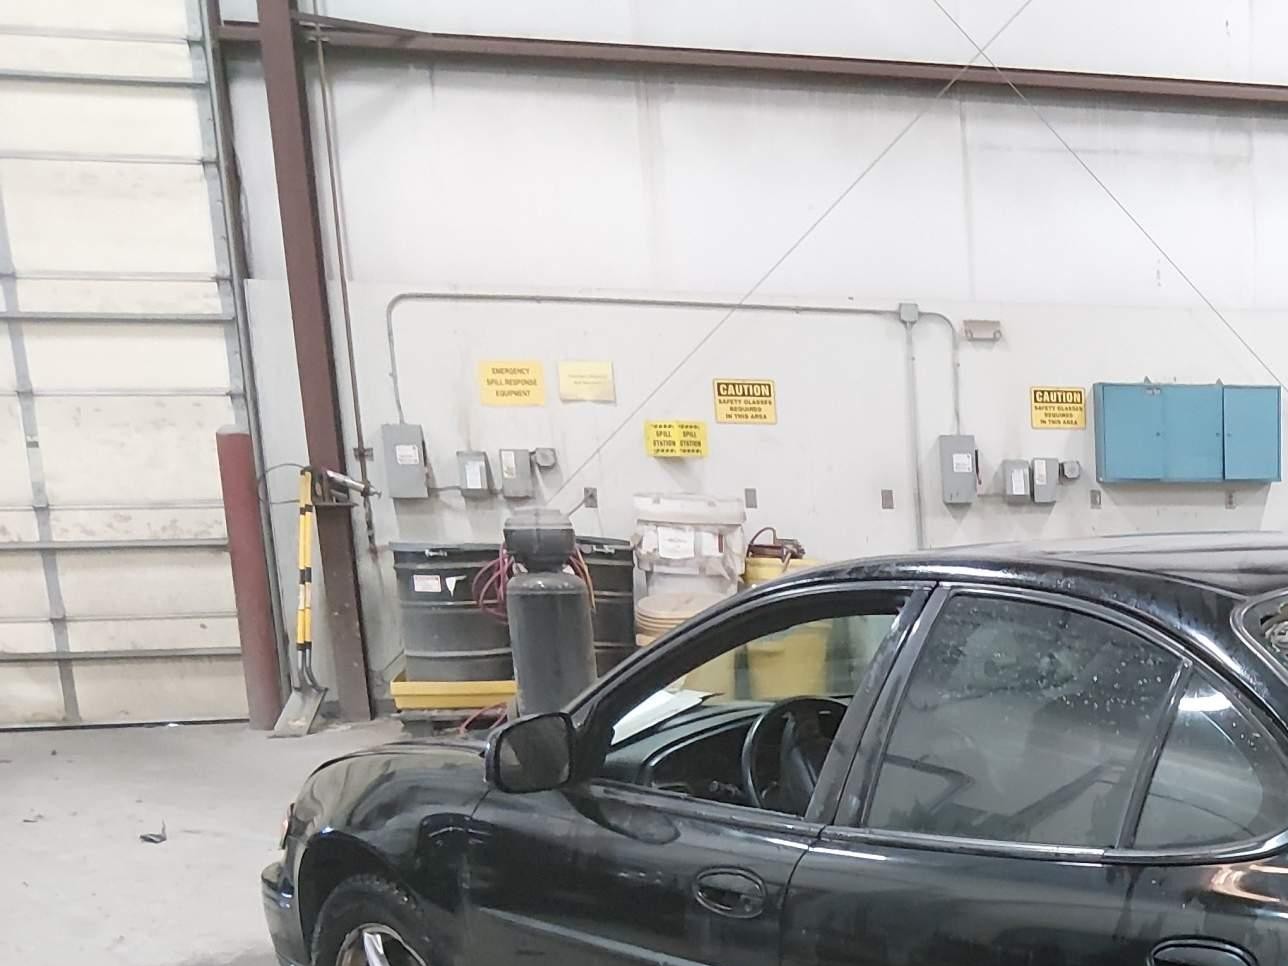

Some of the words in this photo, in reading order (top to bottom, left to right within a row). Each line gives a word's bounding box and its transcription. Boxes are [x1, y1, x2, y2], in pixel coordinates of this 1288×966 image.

[491, 367, 530, 375] EMERGENCY
[486, 378, 504, 386] SPILL
[504, 378, 537, 386] RESPONSE
[720, 384, 769, 396] CAUTION
[1035, 391, 1081, 403] CAUTION
[656, 430, 672, 438] SPILL
[682, 430, 697, 438] SPILL
